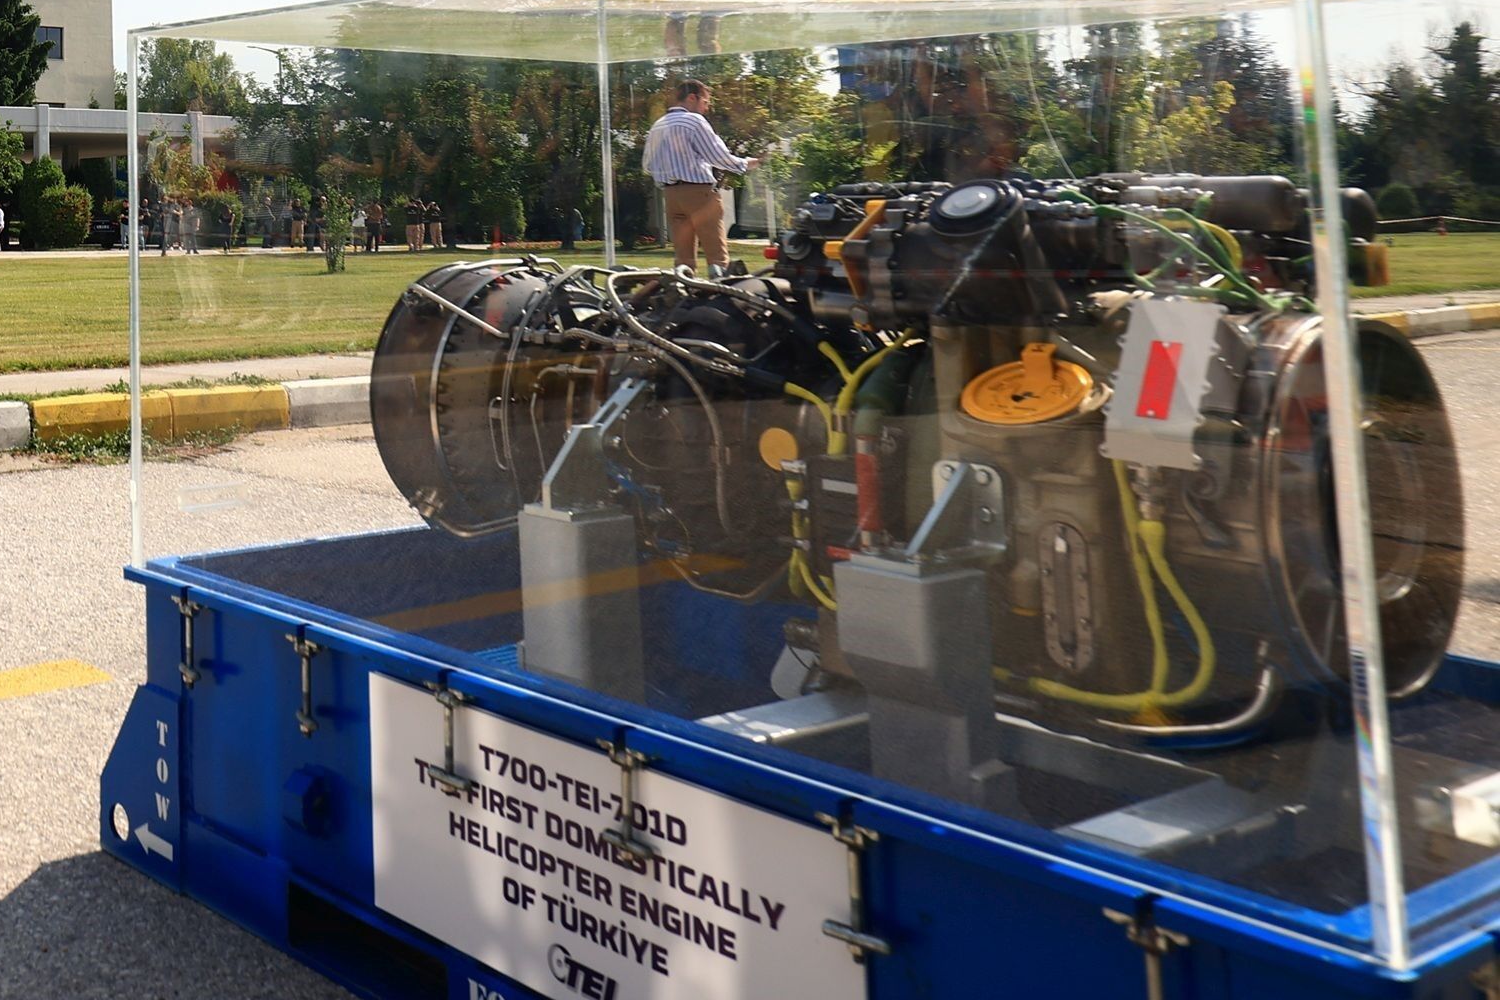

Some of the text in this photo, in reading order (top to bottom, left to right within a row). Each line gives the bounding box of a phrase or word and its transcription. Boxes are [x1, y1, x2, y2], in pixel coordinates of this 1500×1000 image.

[155, 719, 170, 822] TOW
[466, 778, 539, 830] FIRST
[478, 743, 687, 846] T700-TEI-701D
[449, 810, 737, 961] HELICOPTER ENGINE
[502, 876, 670, 977] OF TÜRKİYE
[564, 956, 619, 1000] TEI
